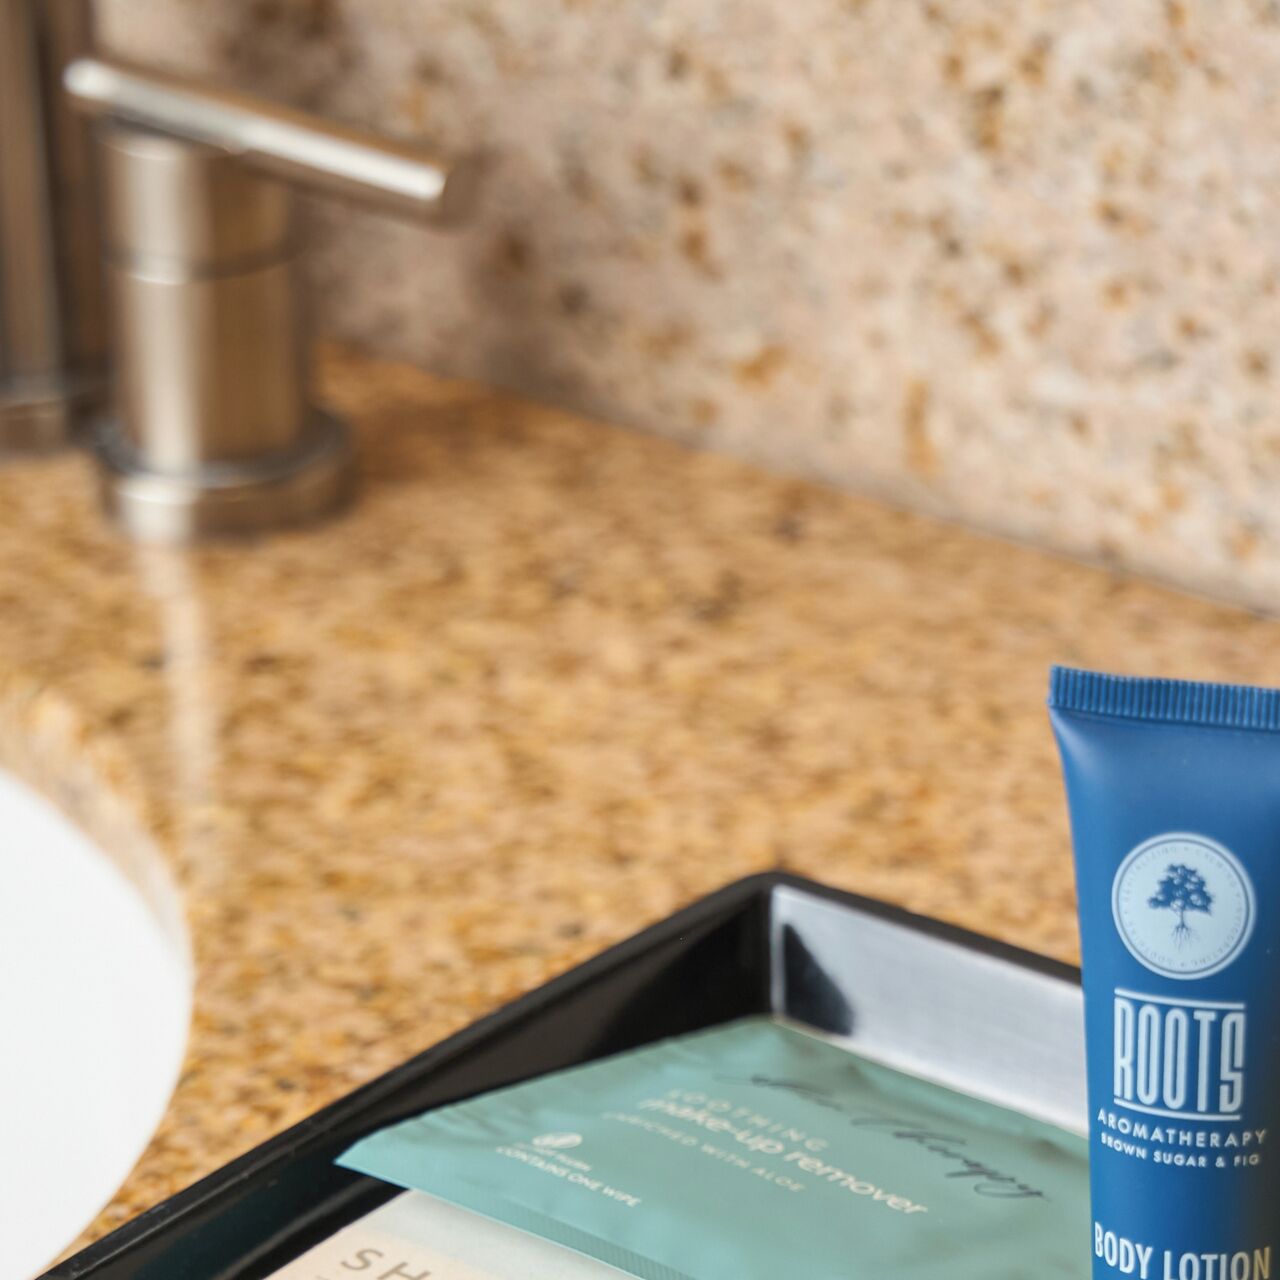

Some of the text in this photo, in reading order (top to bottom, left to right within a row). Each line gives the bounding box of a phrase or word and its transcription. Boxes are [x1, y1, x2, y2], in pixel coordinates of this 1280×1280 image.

[1114, 996, 1245, 1113] ROOTS
[638, 1099, 928, 1214] make-up remover
[1097, 1107, 1267, 1148] AROMATHERAPY
[1101, 1132, 1261, 1168] BROWN SUGAR & FIG
[1094, 1221, 1153, 1280] BODY
